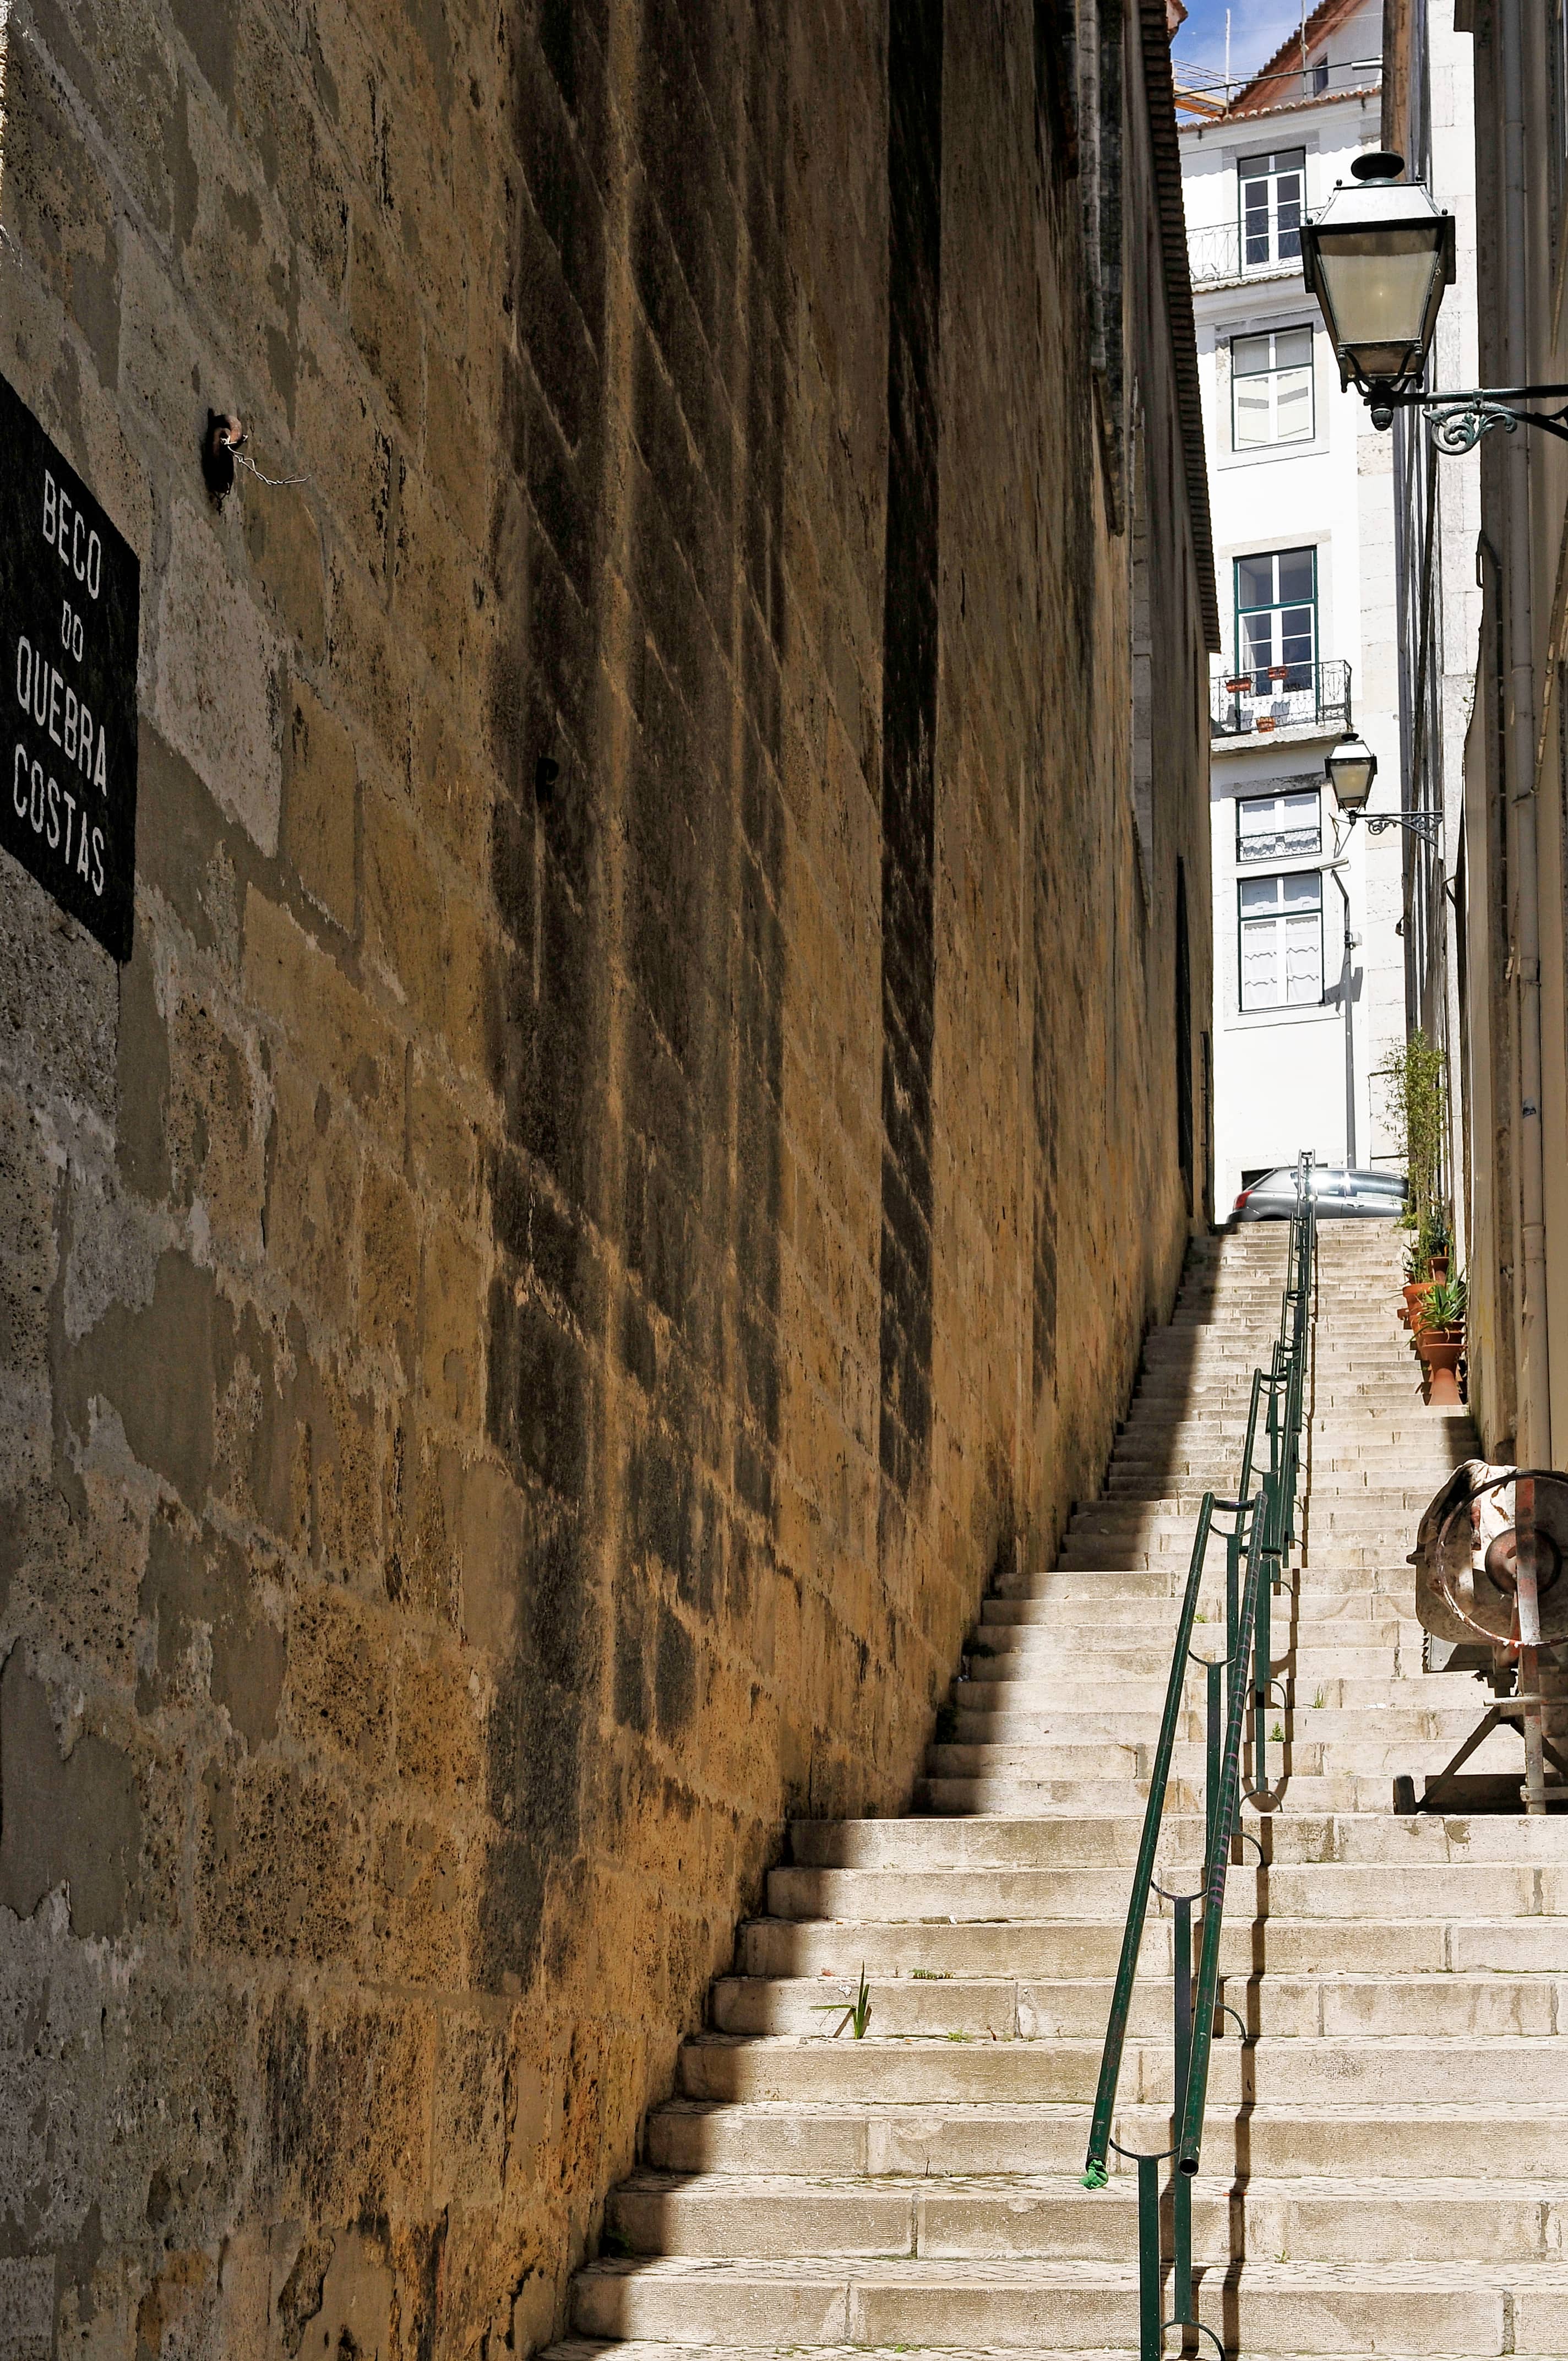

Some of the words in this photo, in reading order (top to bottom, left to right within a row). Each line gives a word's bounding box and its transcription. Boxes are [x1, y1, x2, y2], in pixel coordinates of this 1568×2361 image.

[42, 469, 102, 600] BECO
[61, 599, 84, 663] DO
[17, 635, 107, 797] QUEBRA
[13, 743, 105, 897] COSTAS
